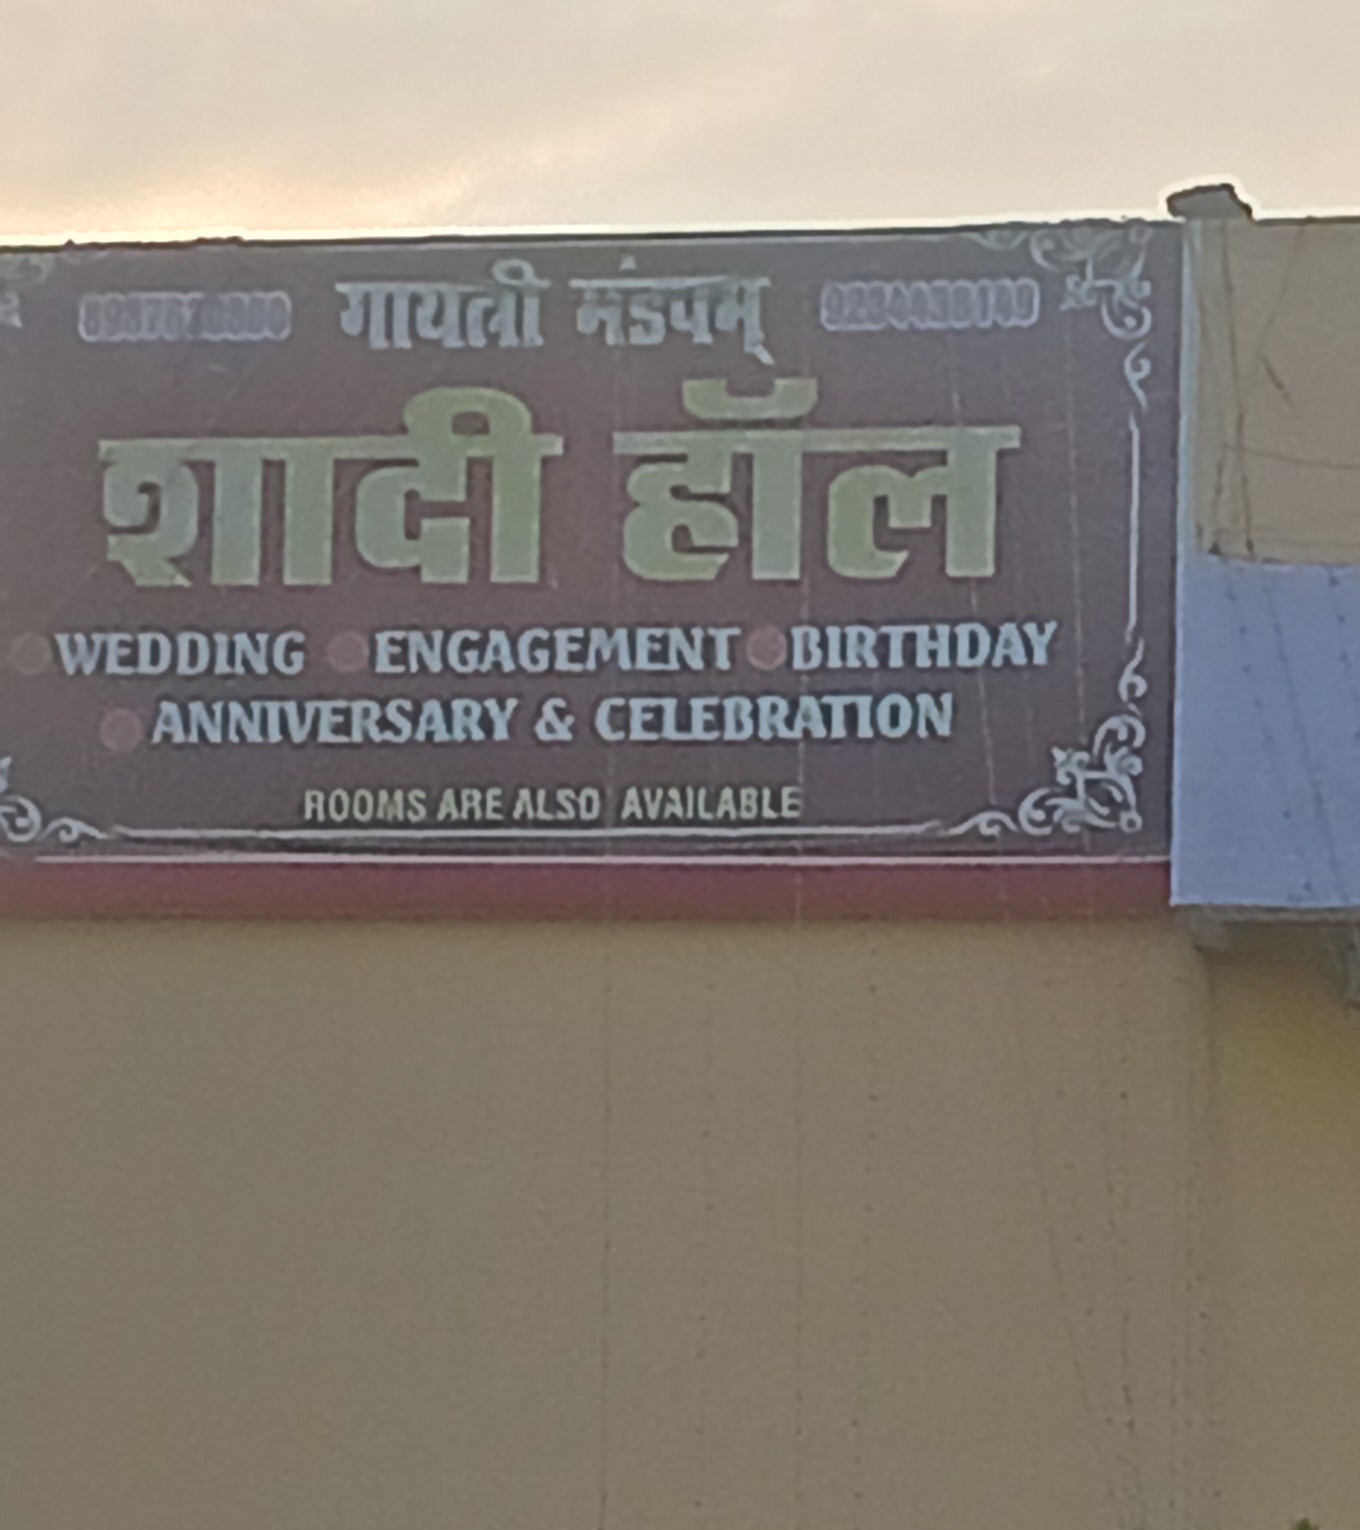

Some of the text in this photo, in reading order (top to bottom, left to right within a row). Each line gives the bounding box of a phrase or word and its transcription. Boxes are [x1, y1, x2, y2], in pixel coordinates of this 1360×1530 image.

[97, 377, 1022, 587] शादी हॉल
[54, 620, 1058, 678] WEDDING ENGAGEMENT BIRTHDAY
[150, 692, 956, 746] ANNIVERSARY & CELEBRATION
[302, 784, 803, 826] ROOMS ARE ALSO AVAILABLE
